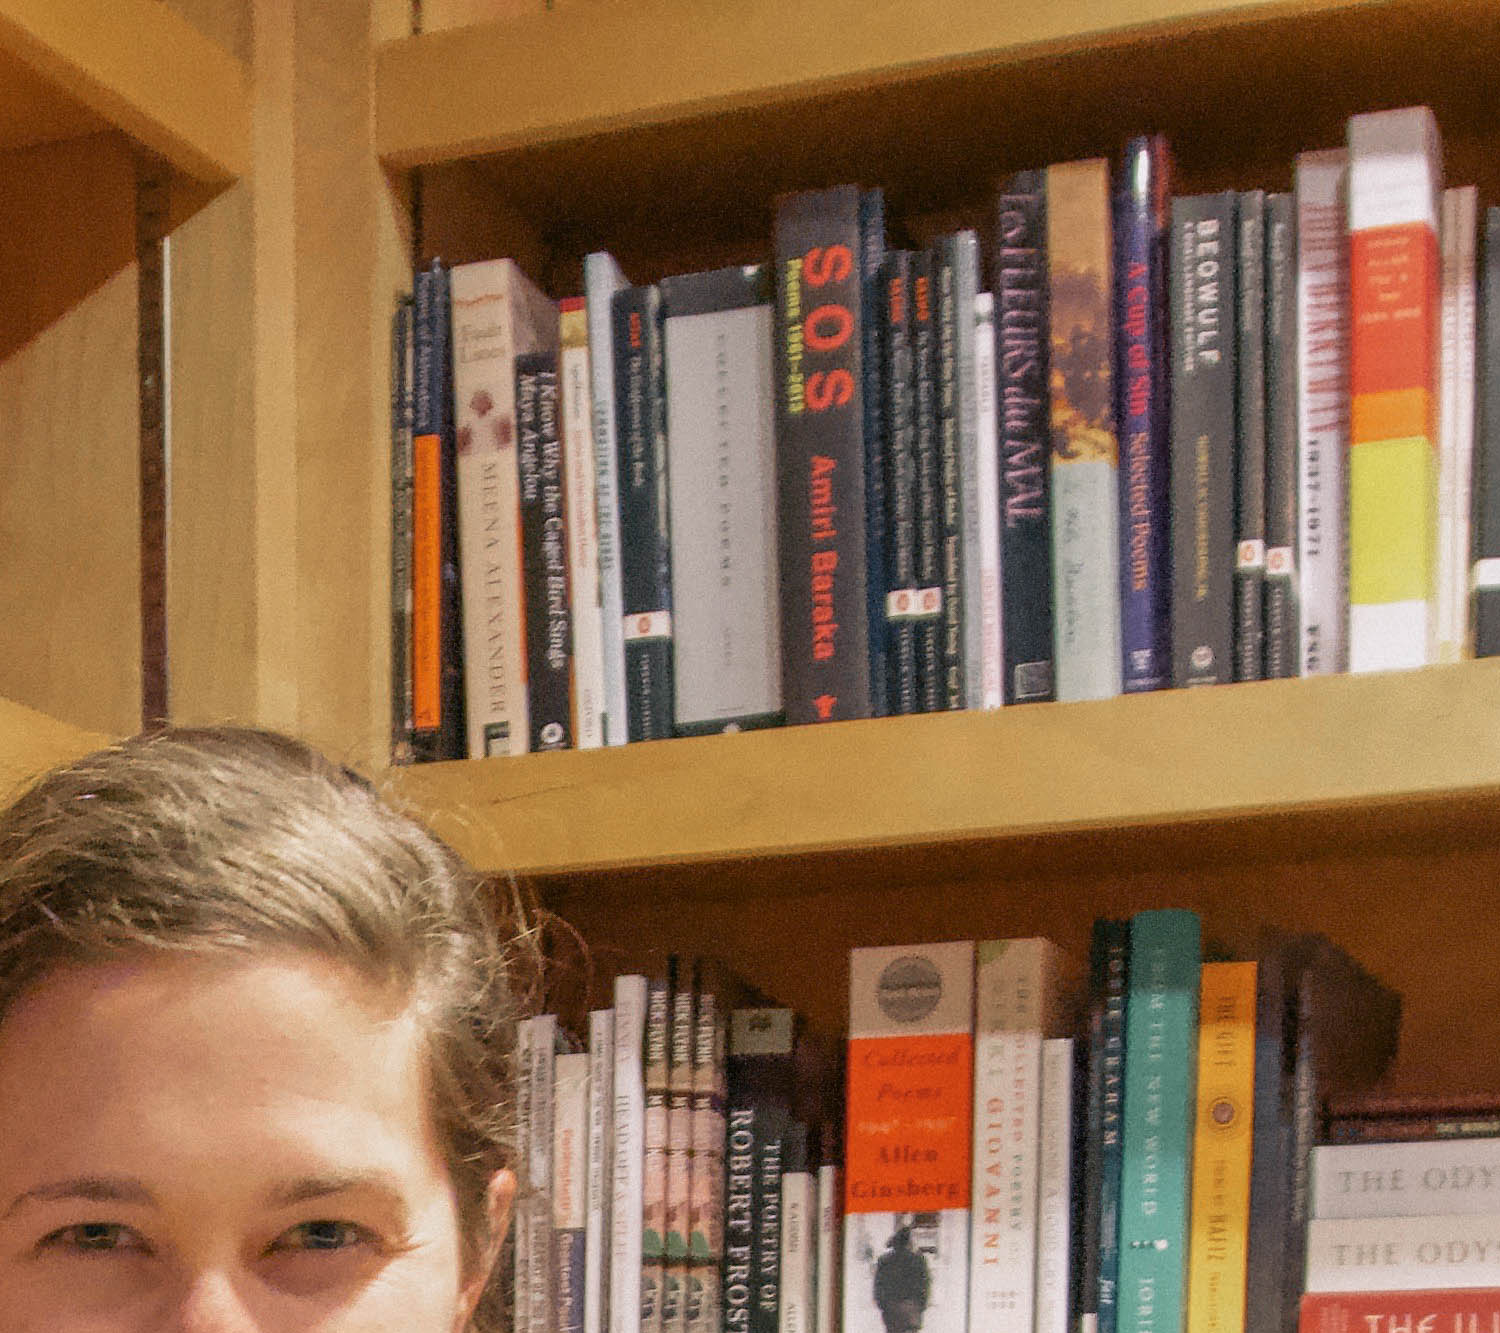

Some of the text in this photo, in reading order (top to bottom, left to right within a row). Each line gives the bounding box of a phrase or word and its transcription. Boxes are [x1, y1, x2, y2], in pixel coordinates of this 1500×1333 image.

[809, 455, 839, 659] Amiri Baraka
[730, 1107, 754, 1226] ROBERT
[871, 1141, 938, 1168] Allen
[849, 1175, 959, 1202] Ginsberg
[1337, 1169, 1405, 1194] THE
